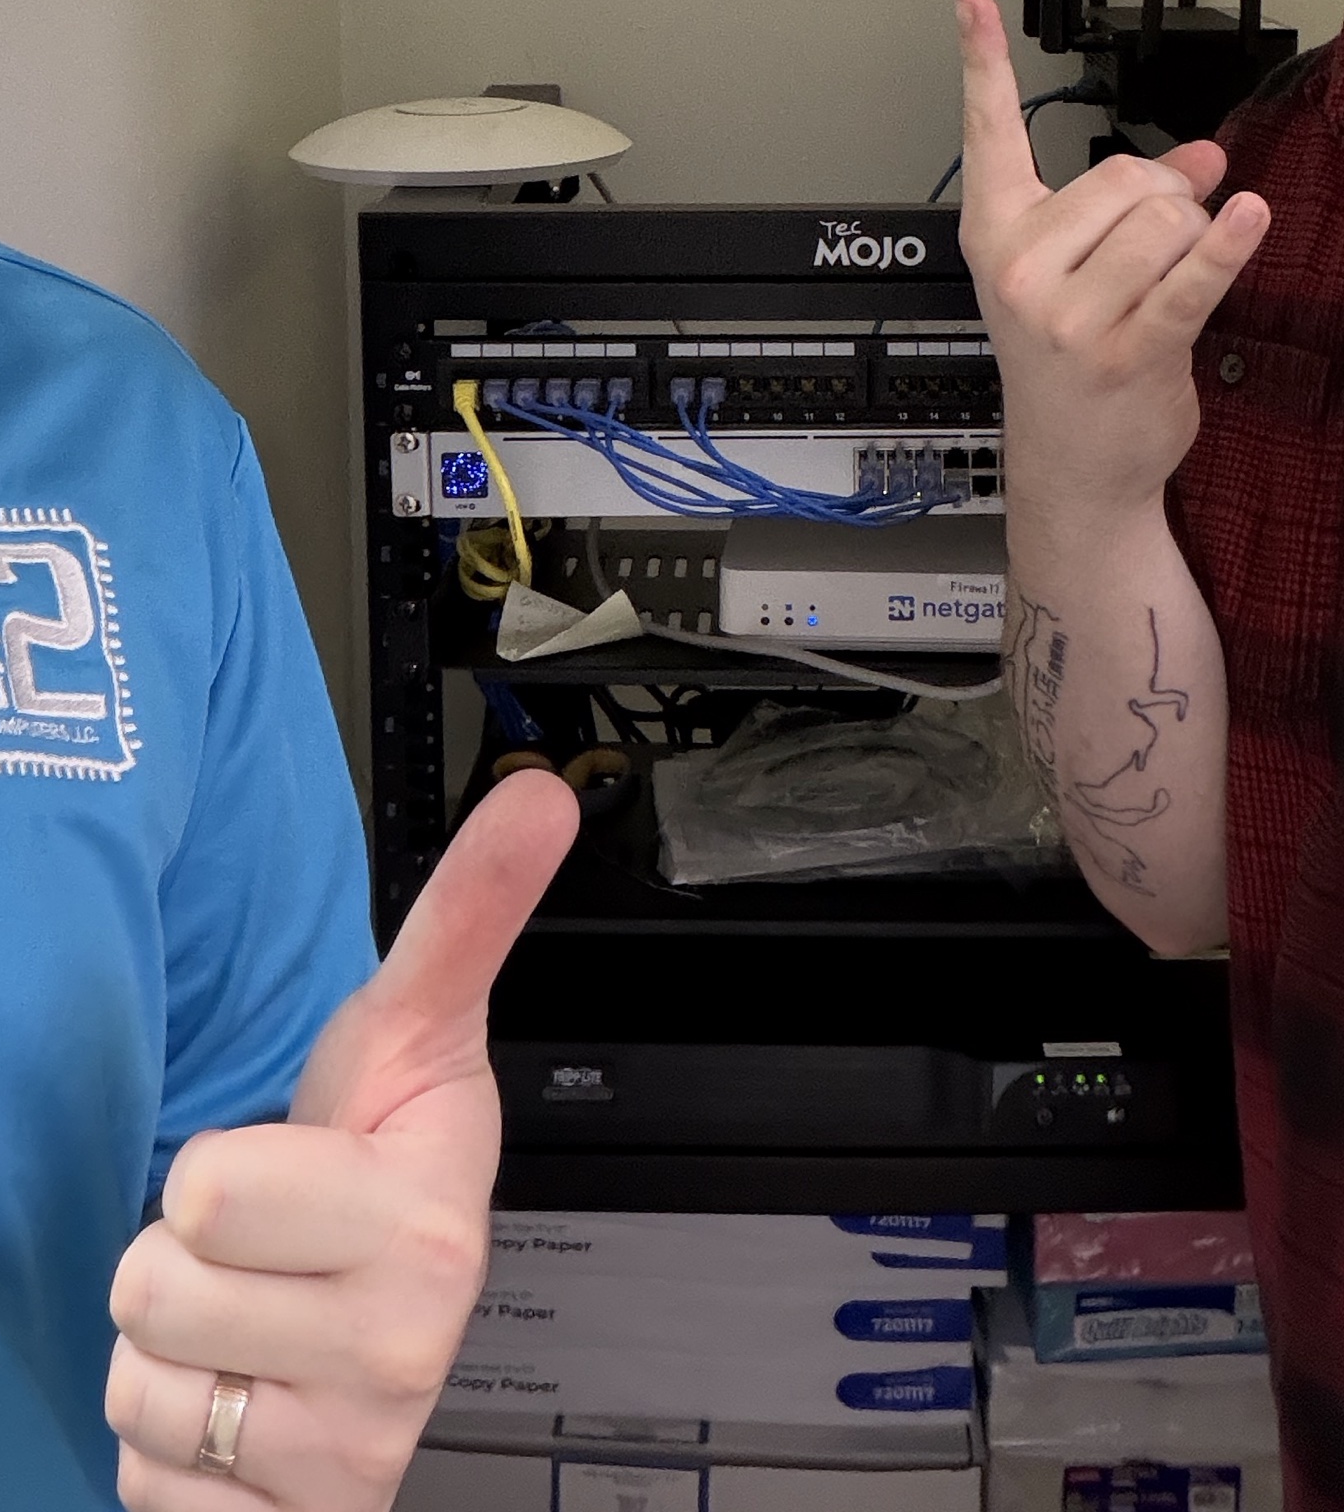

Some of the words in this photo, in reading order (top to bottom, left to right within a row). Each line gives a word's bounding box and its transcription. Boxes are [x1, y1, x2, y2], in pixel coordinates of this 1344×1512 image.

[819, 220, 862, 239] Tec
[813, 236, 927, 270] MOJO
[772, 412, 783, 421] 10
[803, 412, 815, 421] 11
[834, 412, 846, 421] 12
[897, 412, 908, 421] 13
[929, 412, 940, 421] 14
[922, 599, 1005, 624] netgat
[492, 1239, 526, 1252] opy
[532, 1237, 592, 1253] Paper
[498, 1304, 556, 1320] Paper
[501, 1377, 560, 1393] Paper
